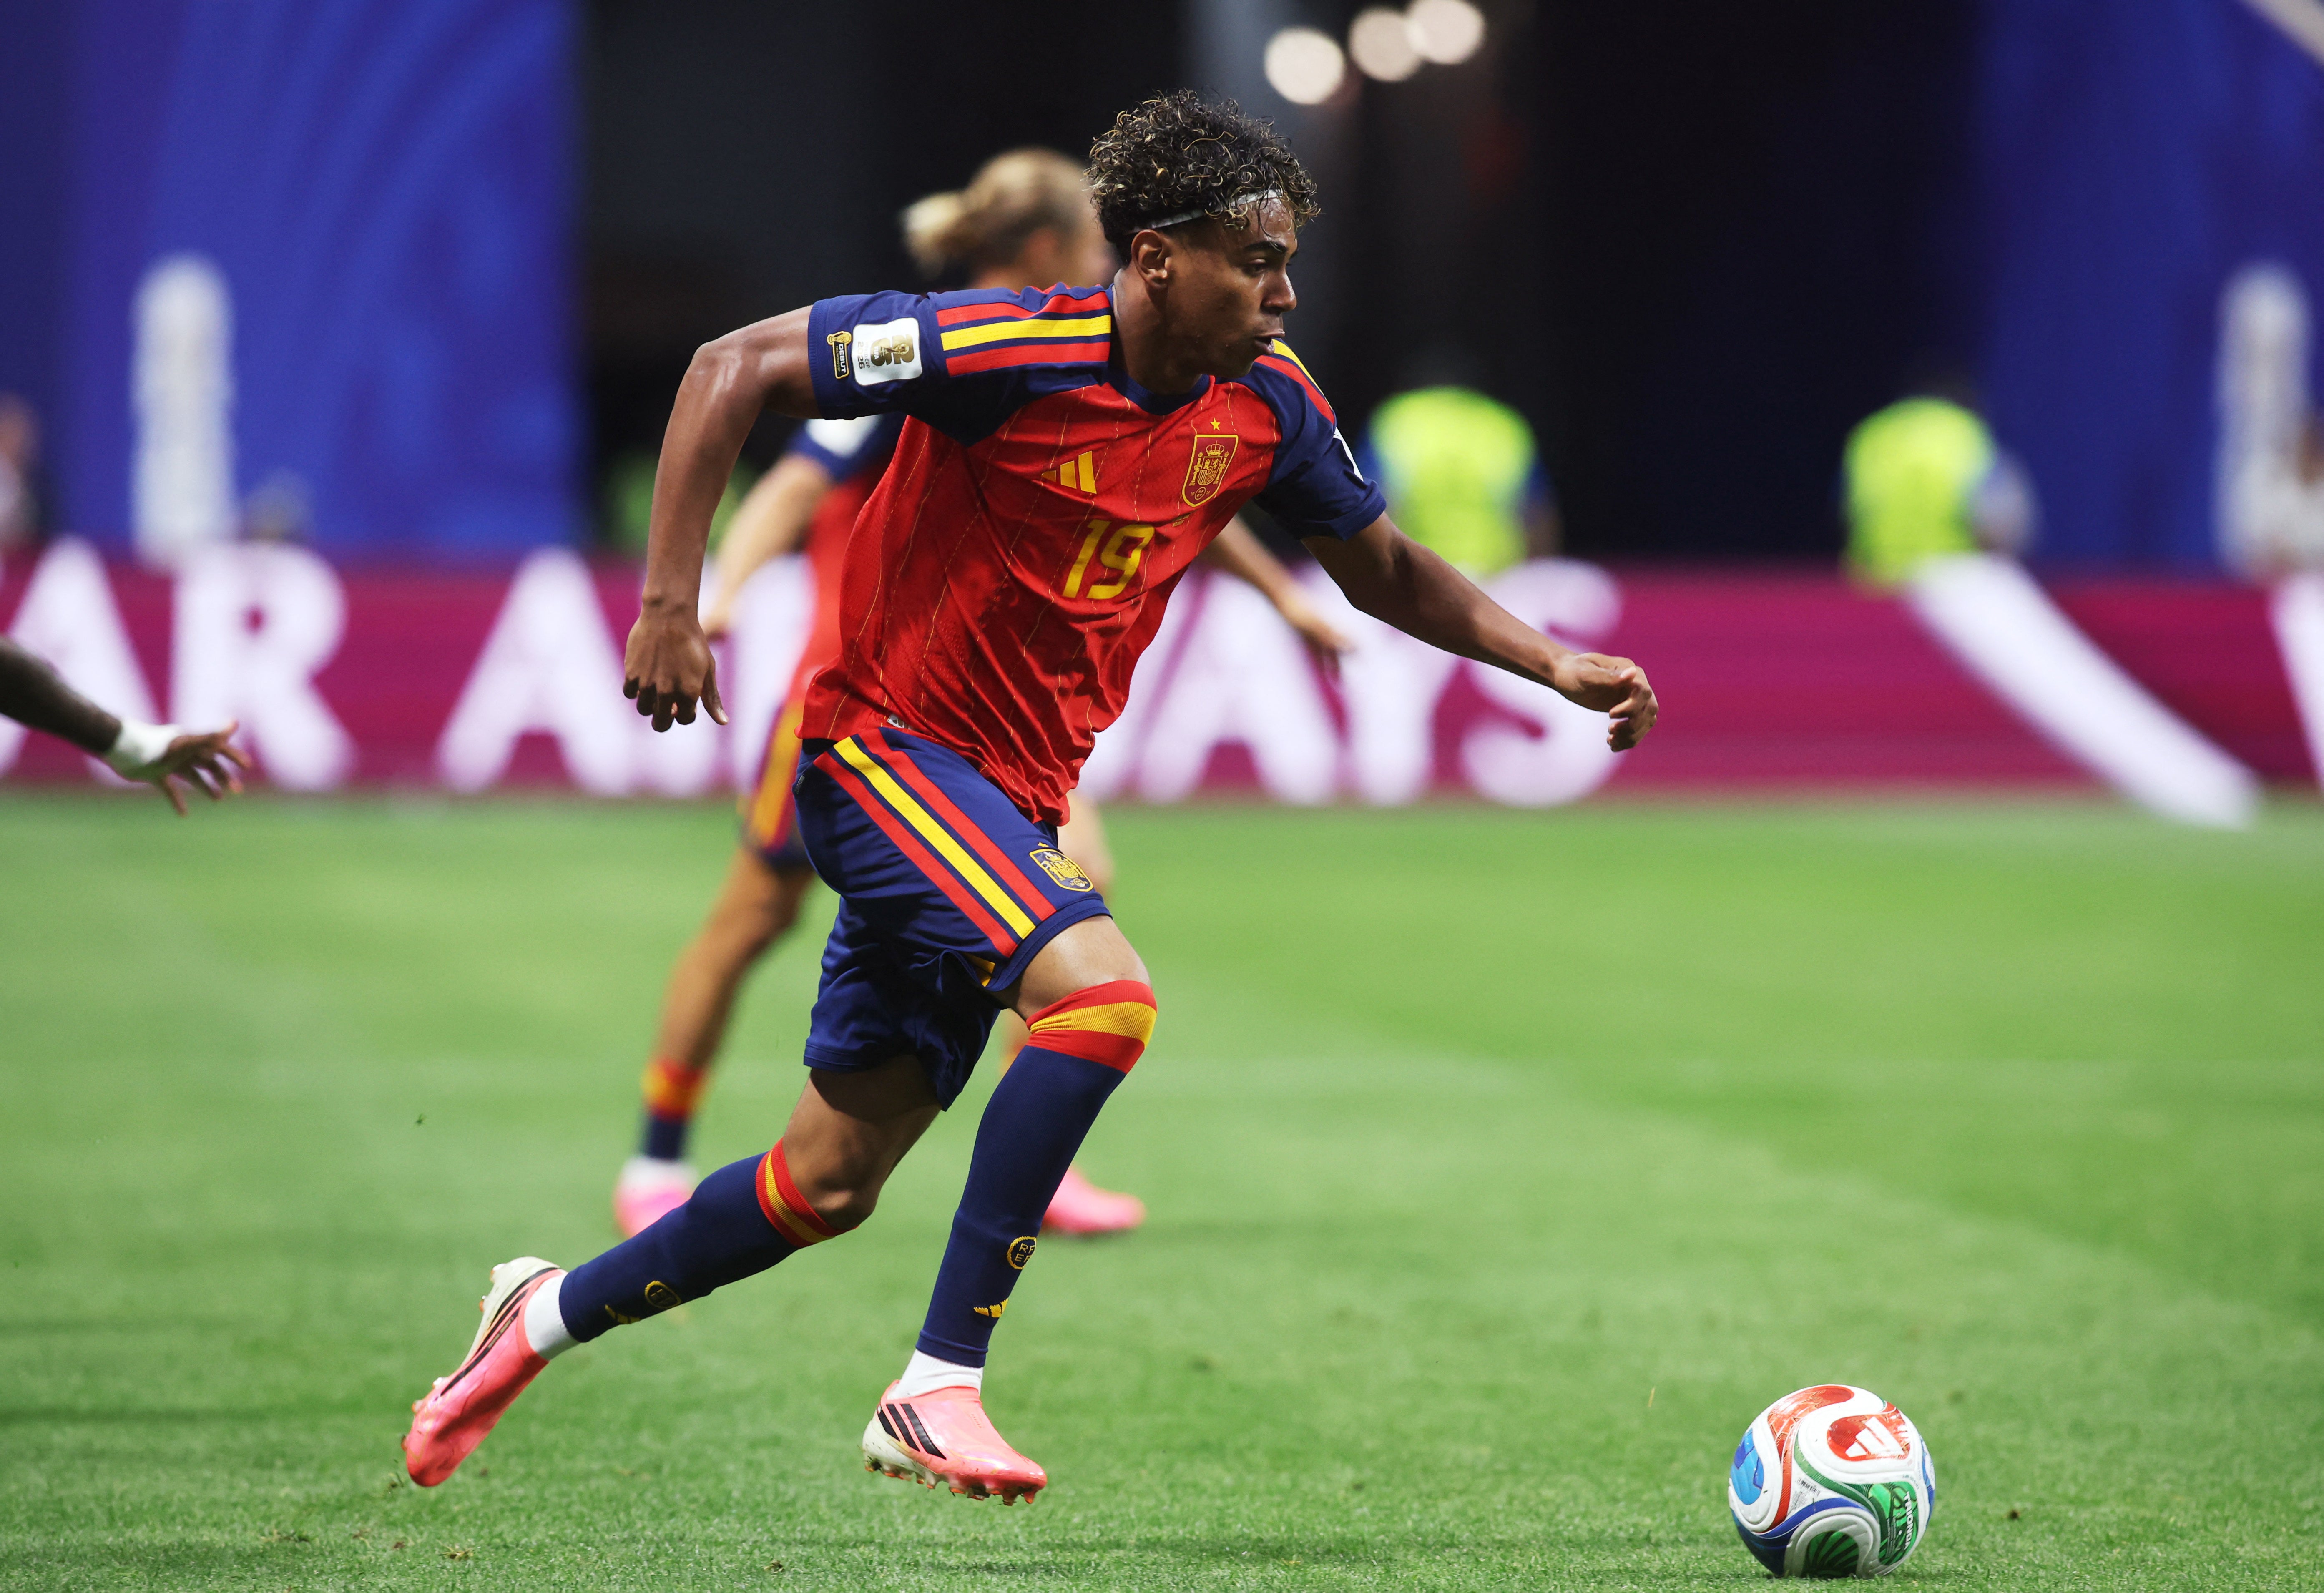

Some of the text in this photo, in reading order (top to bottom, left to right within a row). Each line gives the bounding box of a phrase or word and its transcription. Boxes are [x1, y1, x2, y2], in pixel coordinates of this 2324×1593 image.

[1062, 519, 1155, 600] 19
[434, 547, 1623, 807] AAYS
[1019, 1243, 1035, 1254] RF
[1904, 1491, 1914, 1550] TRIONDA
